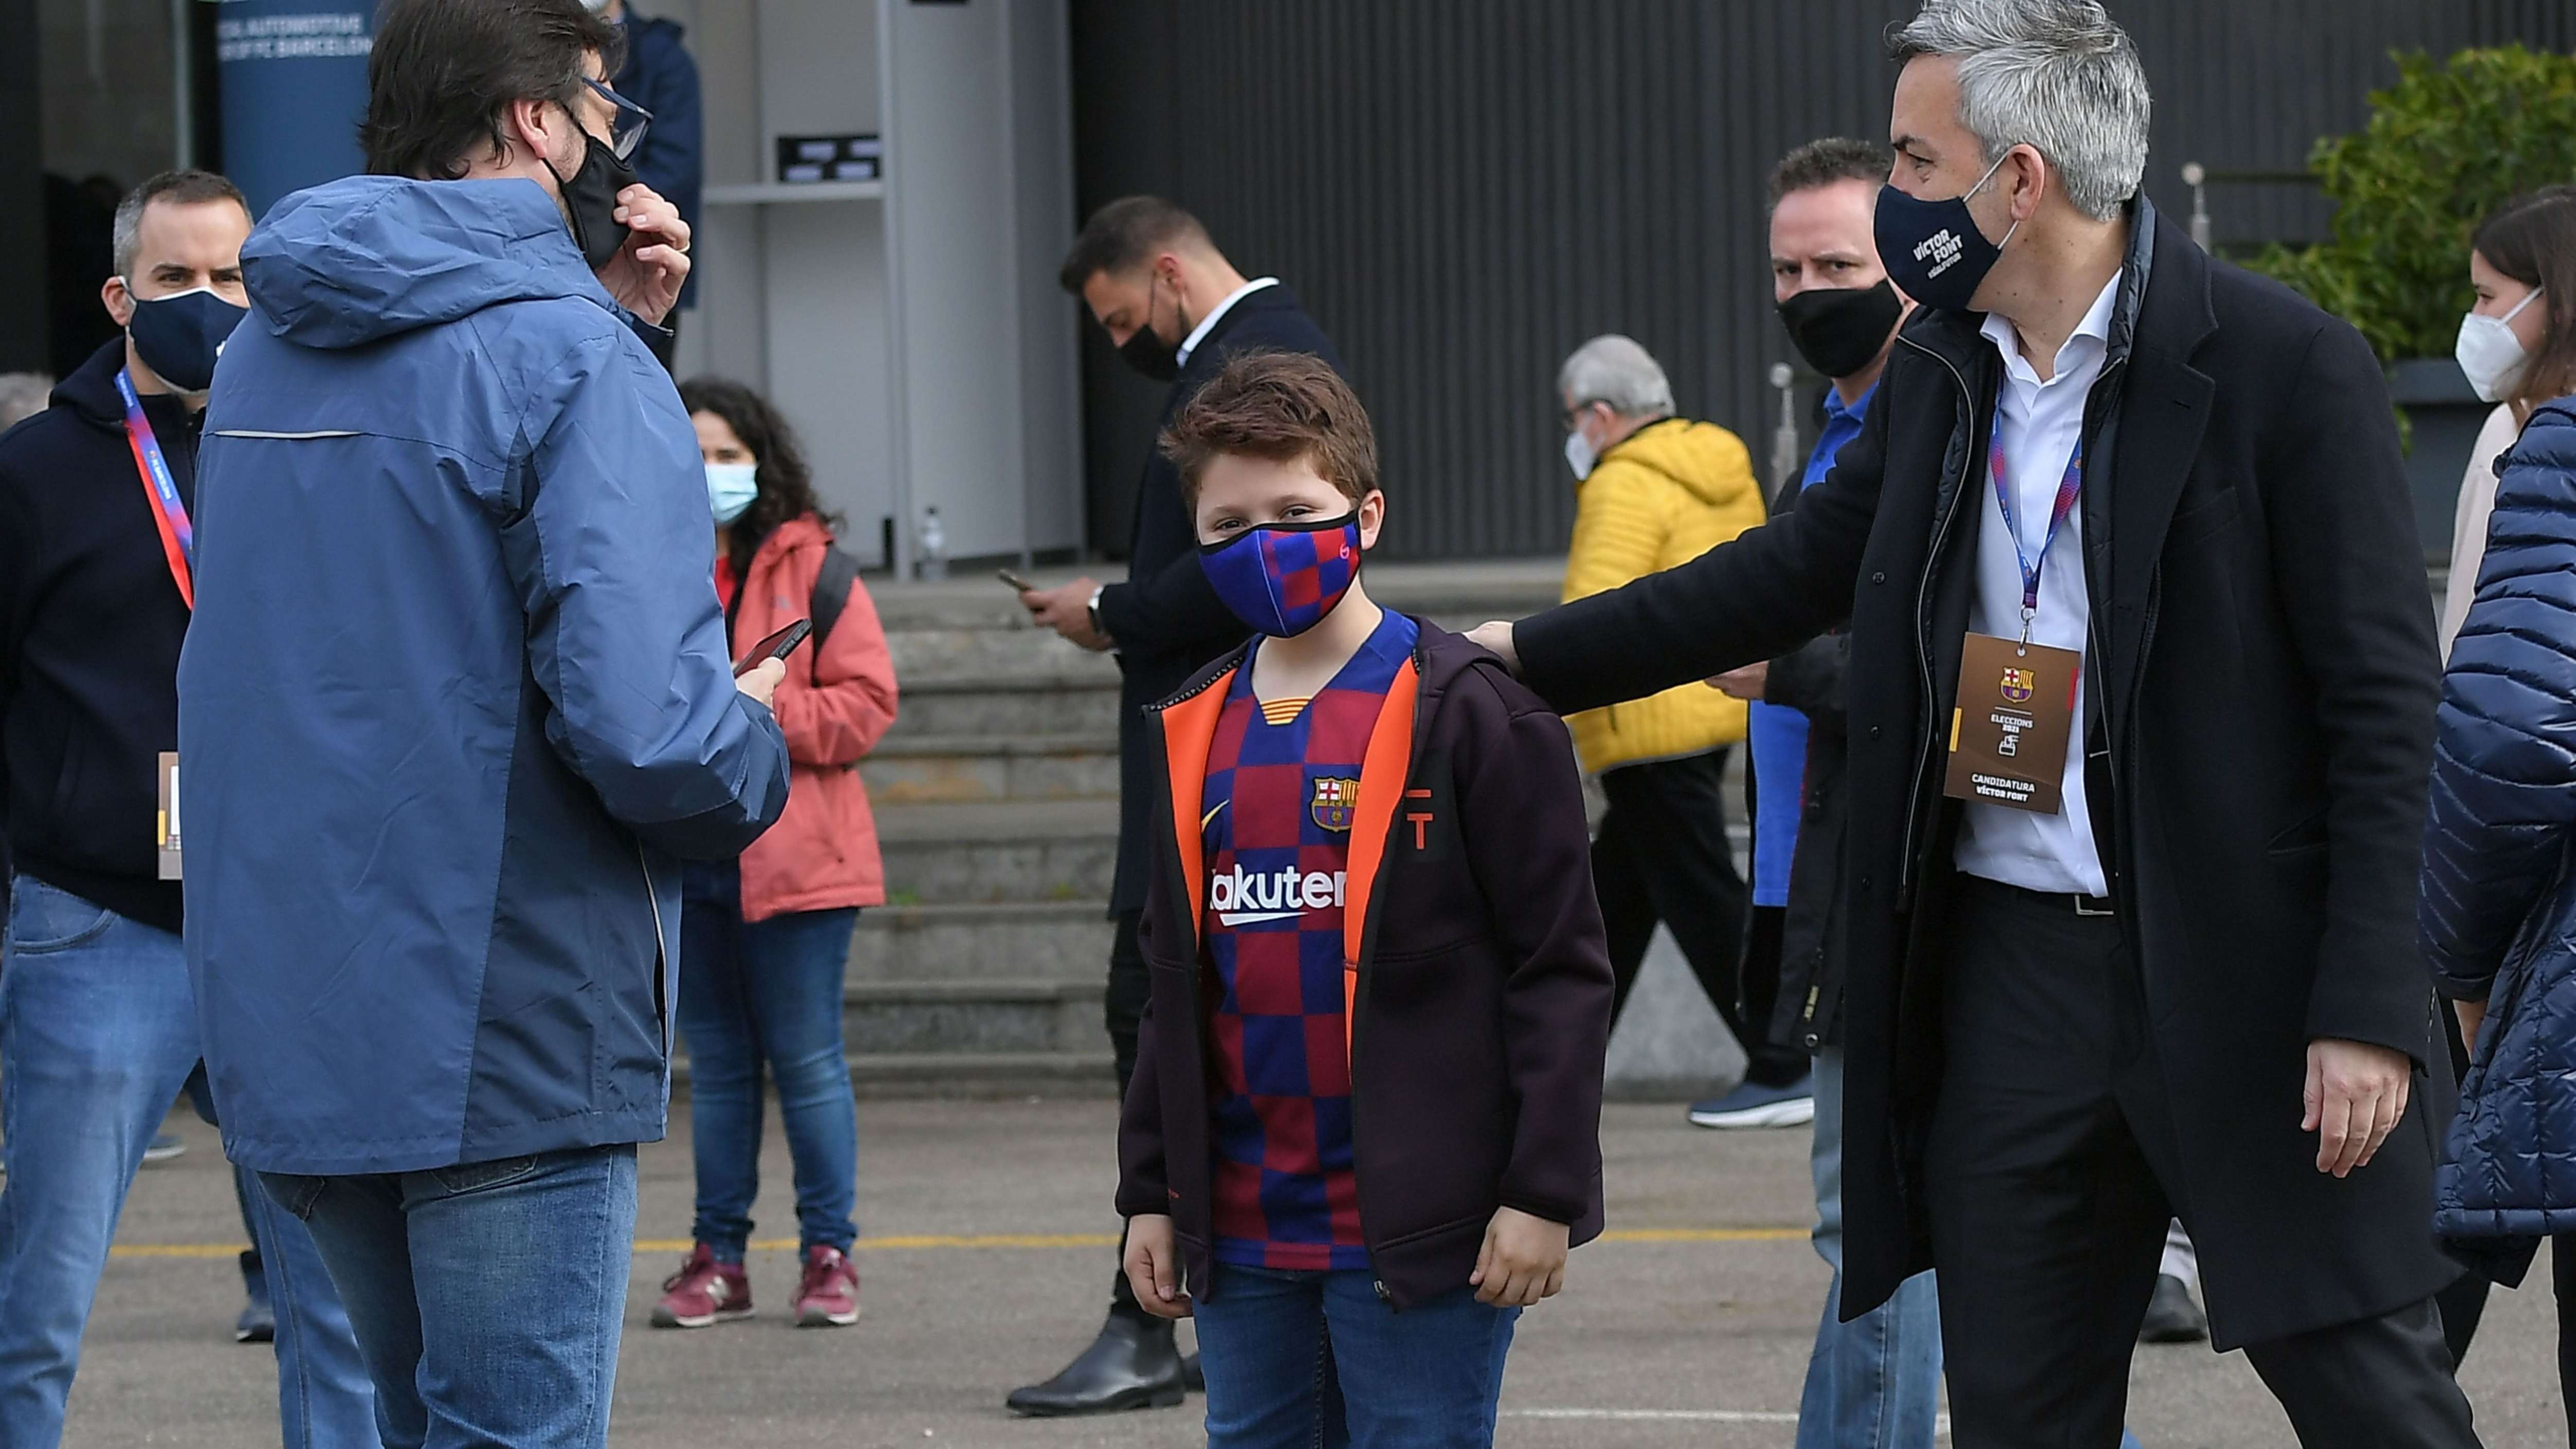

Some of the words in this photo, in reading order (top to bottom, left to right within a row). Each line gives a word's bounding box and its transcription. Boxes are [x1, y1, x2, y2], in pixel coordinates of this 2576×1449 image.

[276, 37, 373, 58] BARCELON
[1913, 229, 1950, 261] VÍCTOR
[1933, 234, 1963, 263] FONT
[1991, 713, 2033, 728] ELECCIONS
[1971, 774, 2035, 793] CANDIDATURA
[1976, 785, 2006, 798] VÍCTOR
[2007, 791, 2028, 802] FONT
[1210, 863, 1347, 910] akute
